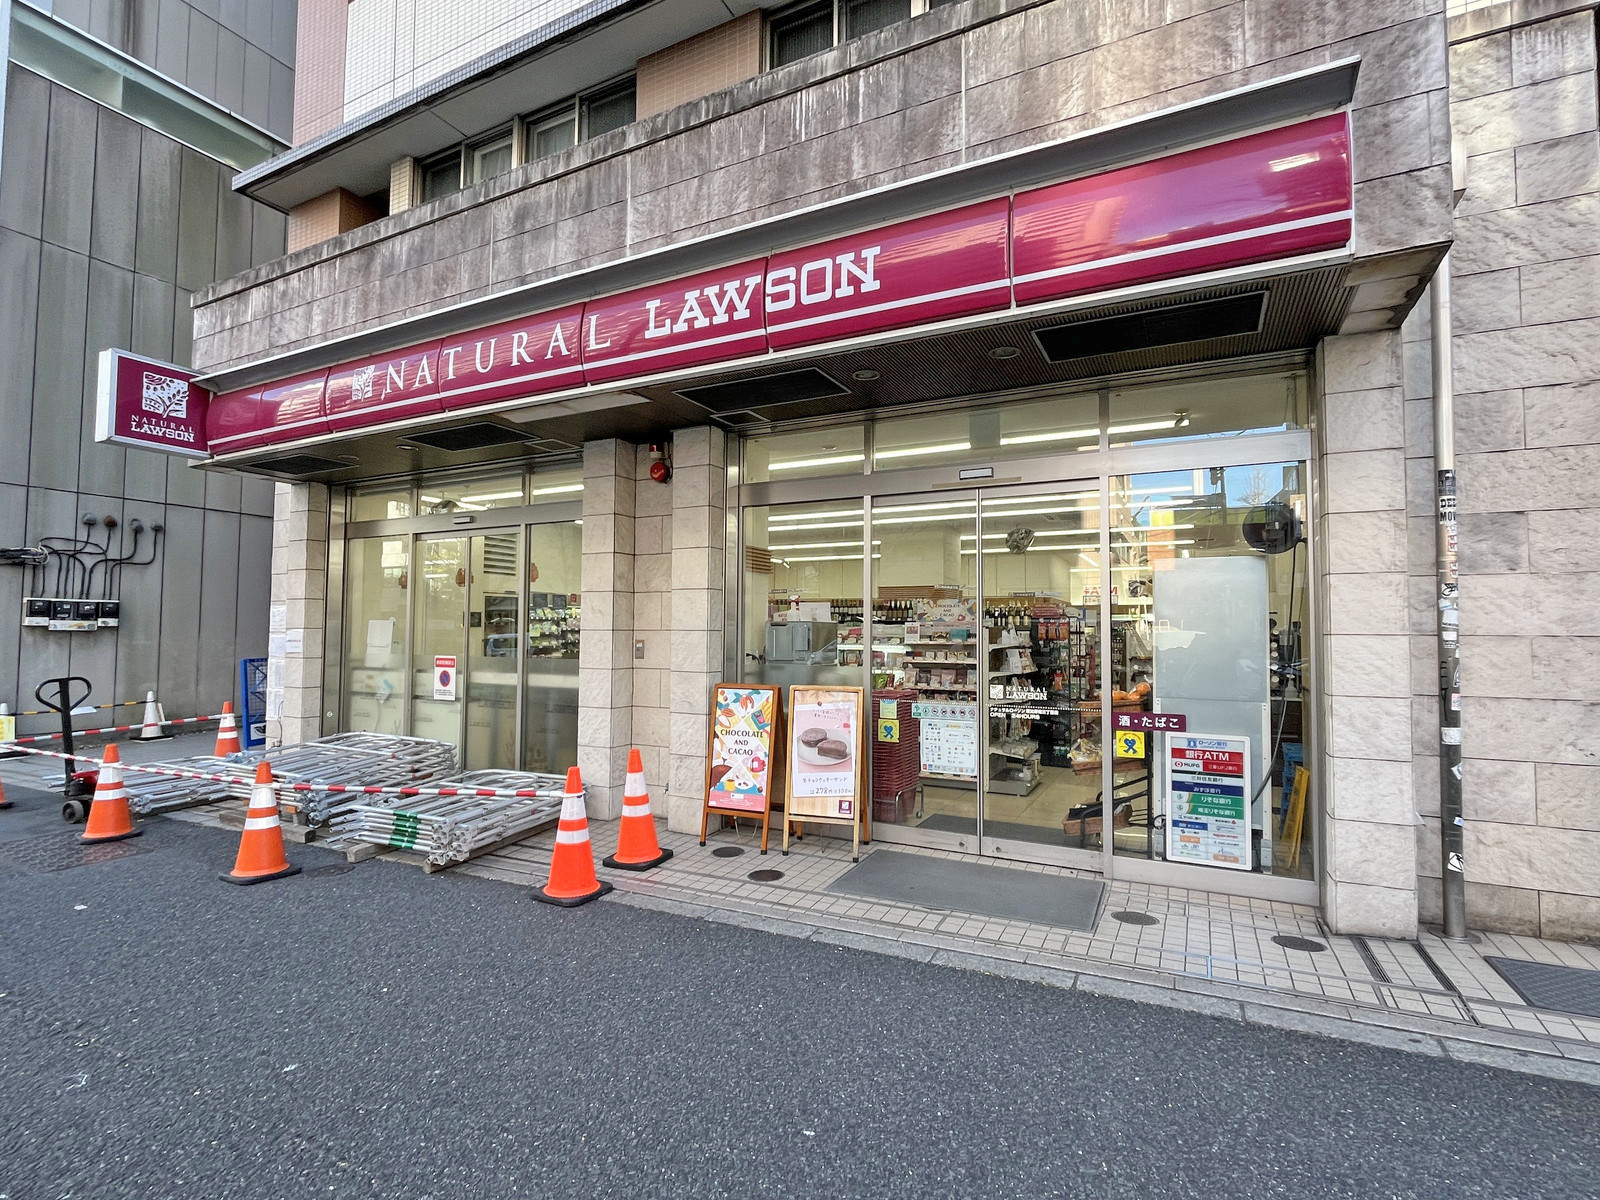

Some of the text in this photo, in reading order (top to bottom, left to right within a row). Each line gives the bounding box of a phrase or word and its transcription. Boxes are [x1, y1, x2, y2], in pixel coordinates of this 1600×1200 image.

[384, 246, 881, 394] NATURAL LAWSON
[131, 415, 195, 433] NATURAL
[130, 422, 195, 442] LAWSON
[1005, 692, 1048, 700] LAWSON
[1118, 715, 1180, 728] 酒・たばこ
[720, 729, 764, 738] CHOCOLATE
[728, 748, 753, 756] CACAO
[1185, 749, 1230, 761] 銀行ATM
